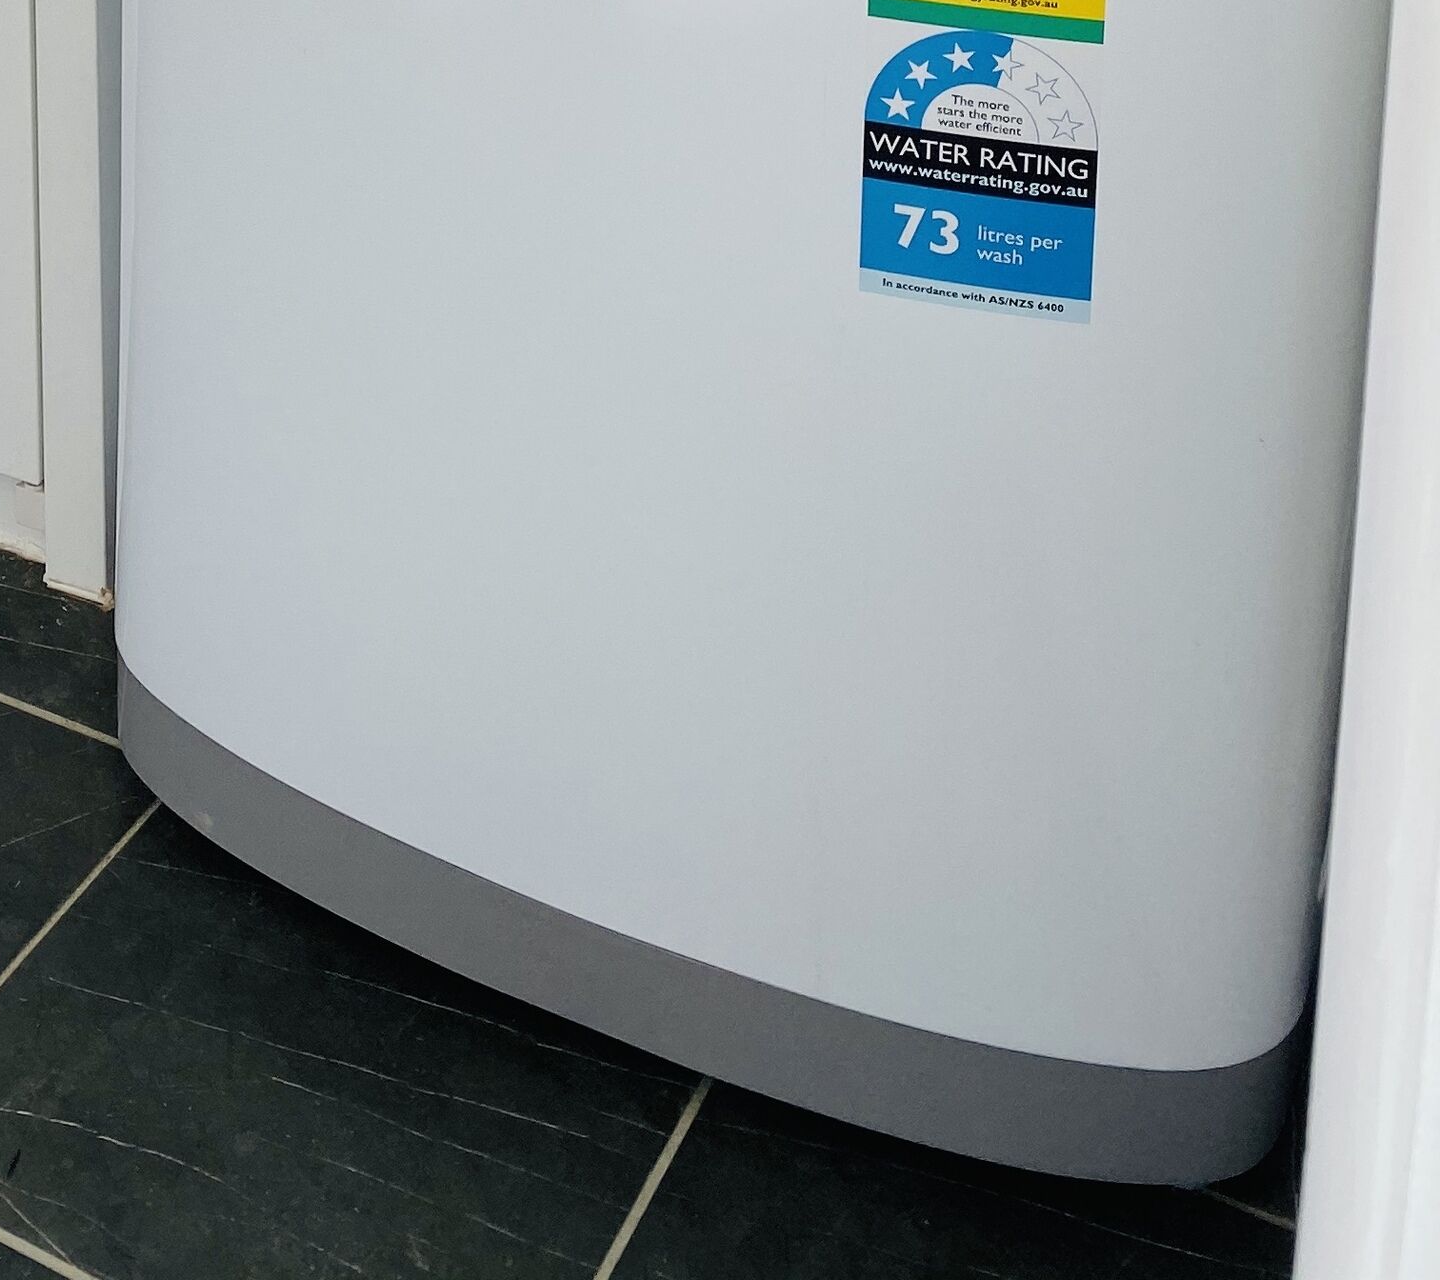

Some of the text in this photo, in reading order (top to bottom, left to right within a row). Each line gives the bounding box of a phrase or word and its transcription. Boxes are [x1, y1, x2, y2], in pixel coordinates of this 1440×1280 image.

[938, 106, 1023, 125] stars the more
[952, 94, 1010, 112] The more
[938, 118, 1022, 136] water efficient
[869, 131, 1088, 180] WATER RATING
[869, 158, 1088, 198] www.waterrating.gov.au
[894, 203, 959, 254] 73
[978, 224, 1064, 252] litres per
[977, 248, 1023, 265] wash
[882, 278, 1064, 312] In accordance with AS/NZS 6400
